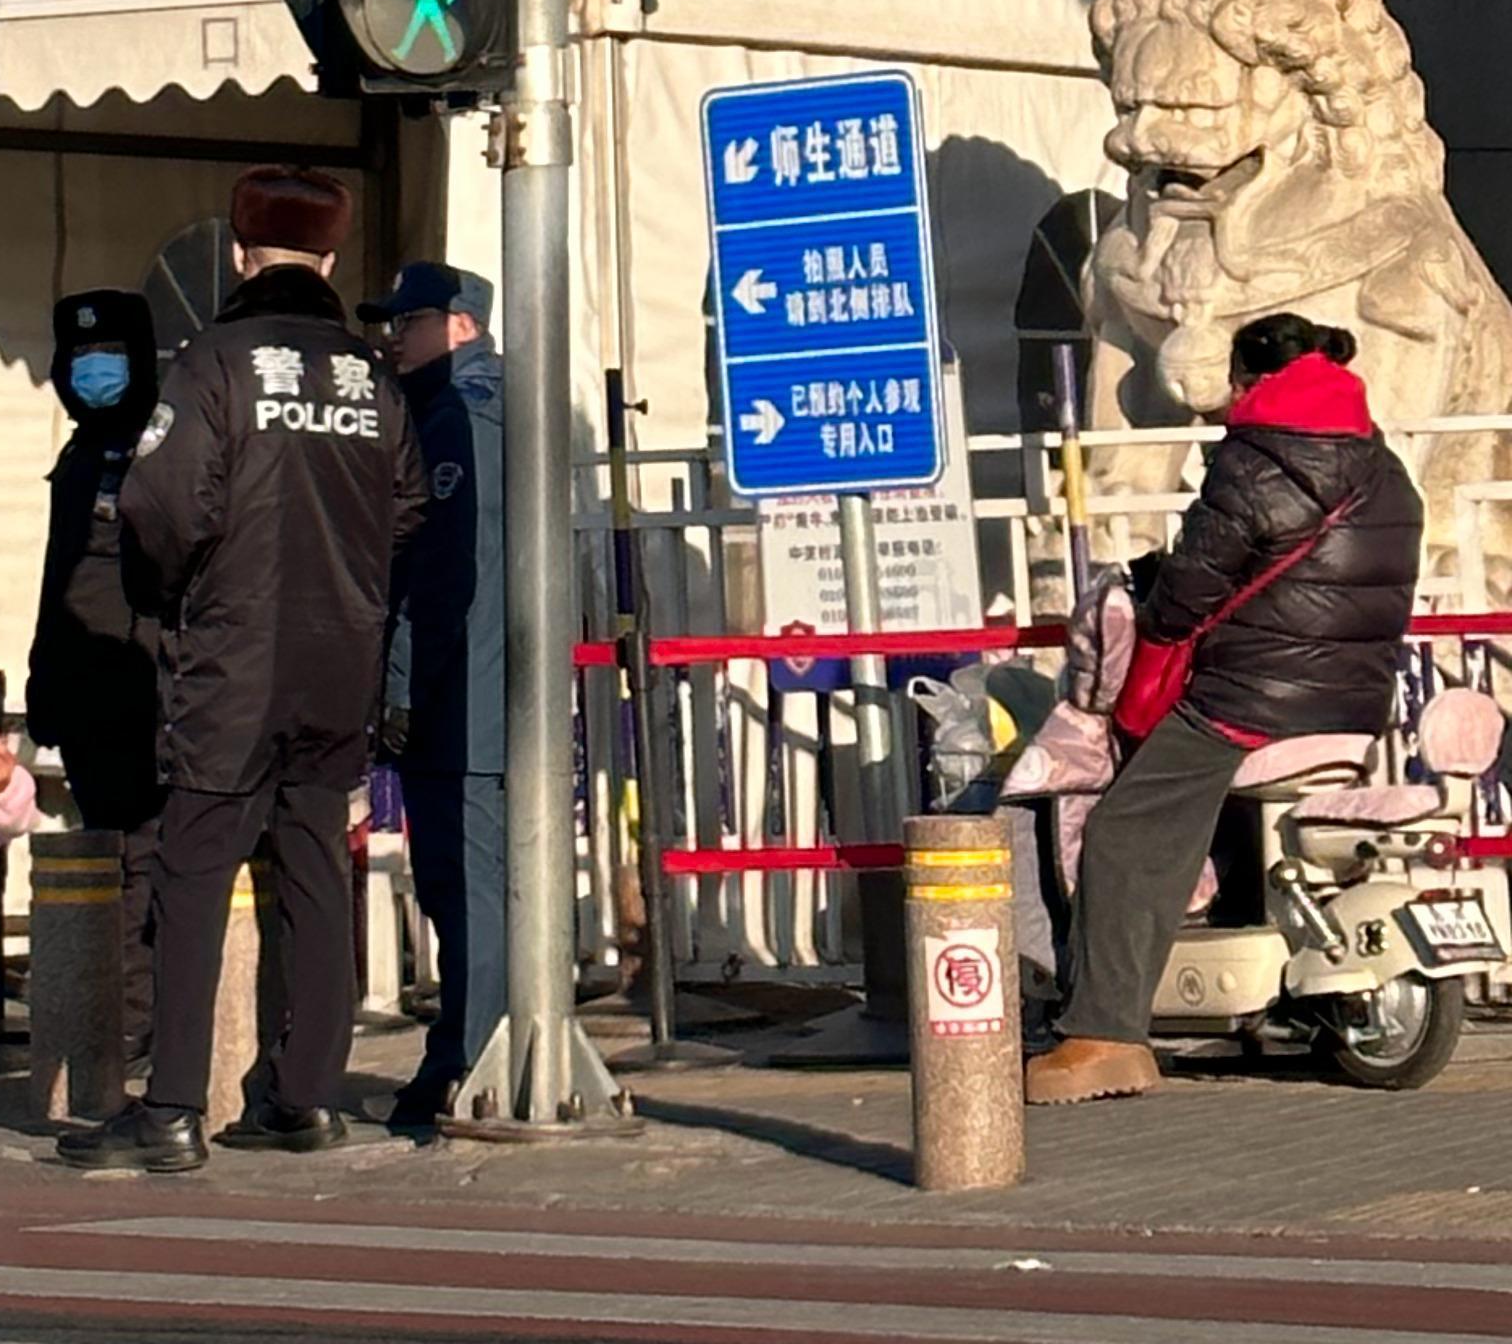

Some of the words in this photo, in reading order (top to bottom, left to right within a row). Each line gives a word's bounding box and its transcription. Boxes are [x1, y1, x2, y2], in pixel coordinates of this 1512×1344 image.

[770, 113, 902, 187] 师生通道
[803, 242, 889, 284] 拍照人员
[785, 281, 915, 327] 请到北侧排队
[250, 345, 375, 401] 警察
[255, 399, 380, 438] POLICE
[791, 377, 921, 418] 已预约个人参观
[820, 421, 894, 459] 专用入口
